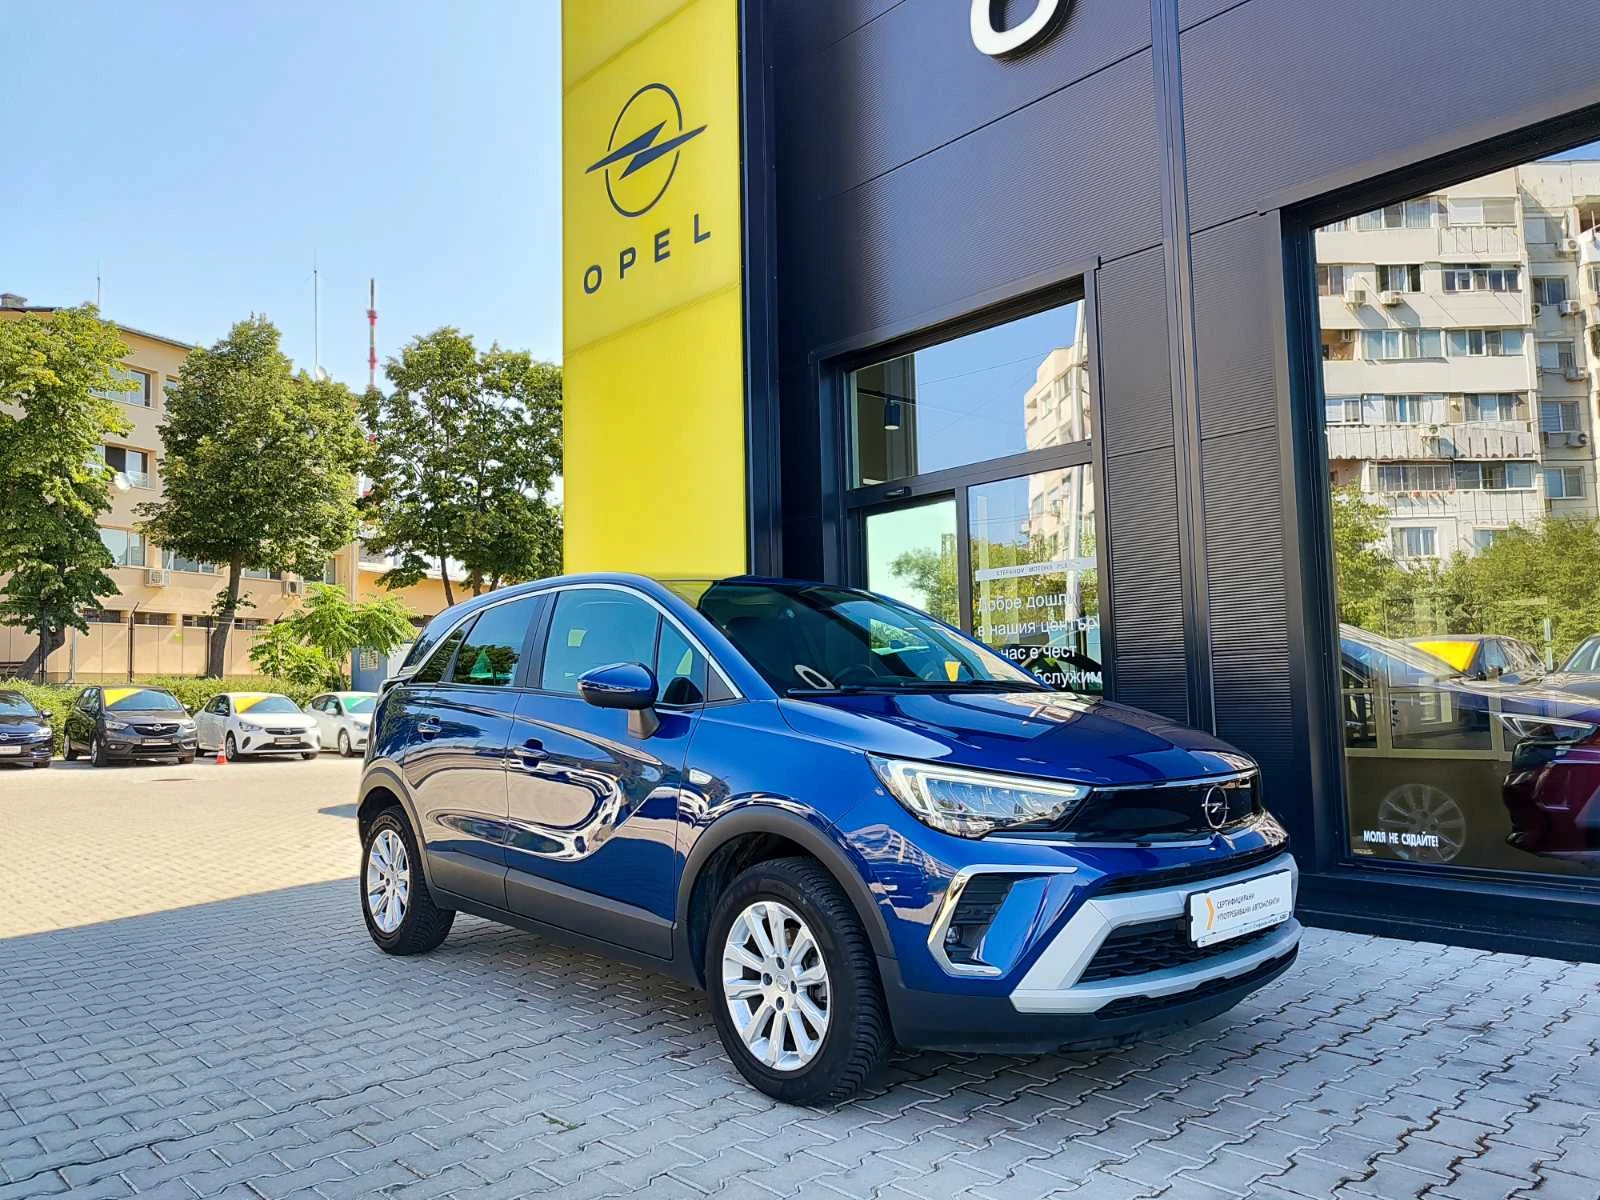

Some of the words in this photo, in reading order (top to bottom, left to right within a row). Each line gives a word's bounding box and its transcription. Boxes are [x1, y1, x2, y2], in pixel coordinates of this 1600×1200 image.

[584, 214, 711, 294] OPEL
[977, 596, 1022, 614] Добре
[990, 621, 1036, 637] нашия
[1029, 647, 1039, 659] е
[1043, 645, 1077, 658] чест
[1363, 830, 1386, 843] МОЛЯ
[1389, 832, 1399, 844] НЕ
[1401, 831, 1439, 847] СЯДАЙТЕ!
